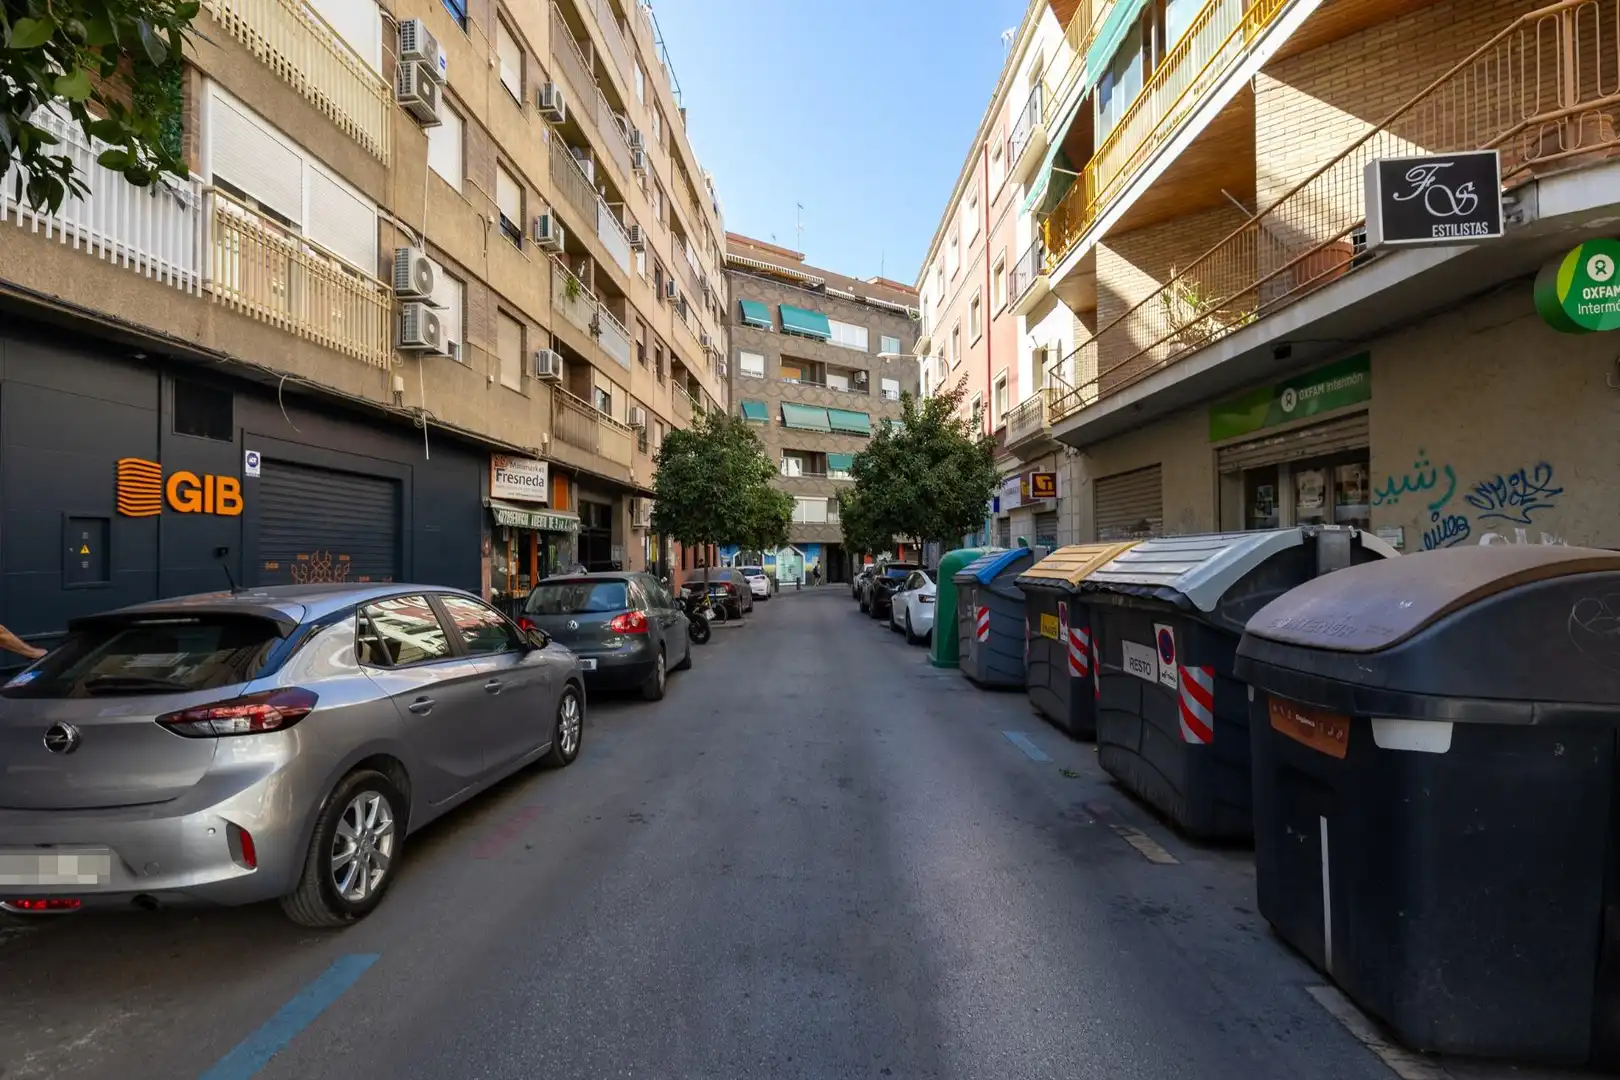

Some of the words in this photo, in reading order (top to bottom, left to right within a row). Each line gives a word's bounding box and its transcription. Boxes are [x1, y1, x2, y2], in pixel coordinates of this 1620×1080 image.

[1432, 221, 1489, 238] ESTILISTAS
[1582, 284, 1620, 300] OXFAM
[1299, 382, 1325, 401] OXFAM
[496, 467, 545, 488] Fresneda
[166, 470, 244, 516] GIB
[1129, 656, 1152, 676] RESTO
